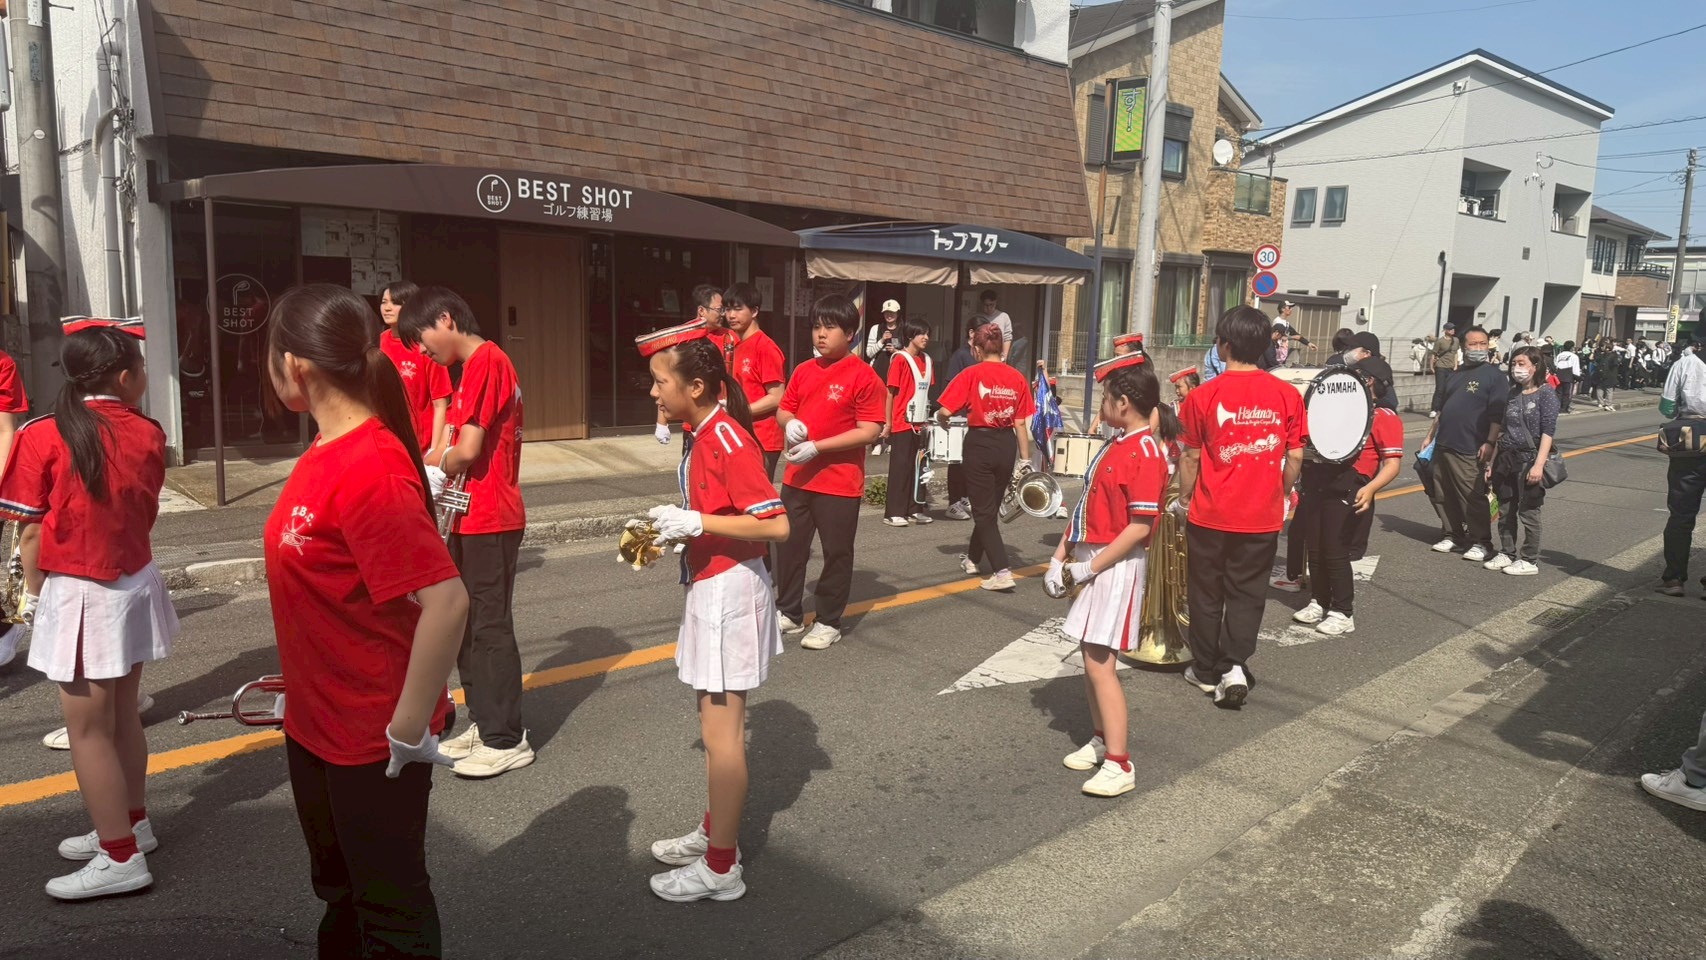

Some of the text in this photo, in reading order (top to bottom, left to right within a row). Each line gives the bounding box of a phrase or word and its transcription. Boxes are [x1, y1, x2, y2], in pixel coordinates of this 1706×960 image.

[518, 178, 633, 209] BEST SHOT
[543, 203, 613, 223] ゴルフ練習場
[929, 229, 1009, 254] トップスター
[1259, 251, 1275, 263] 30
[223, 307, 253, 317] BEST
[222, 318, 255, 328] SHOT
[1326, 381, 1357, 394] YAMAHA
